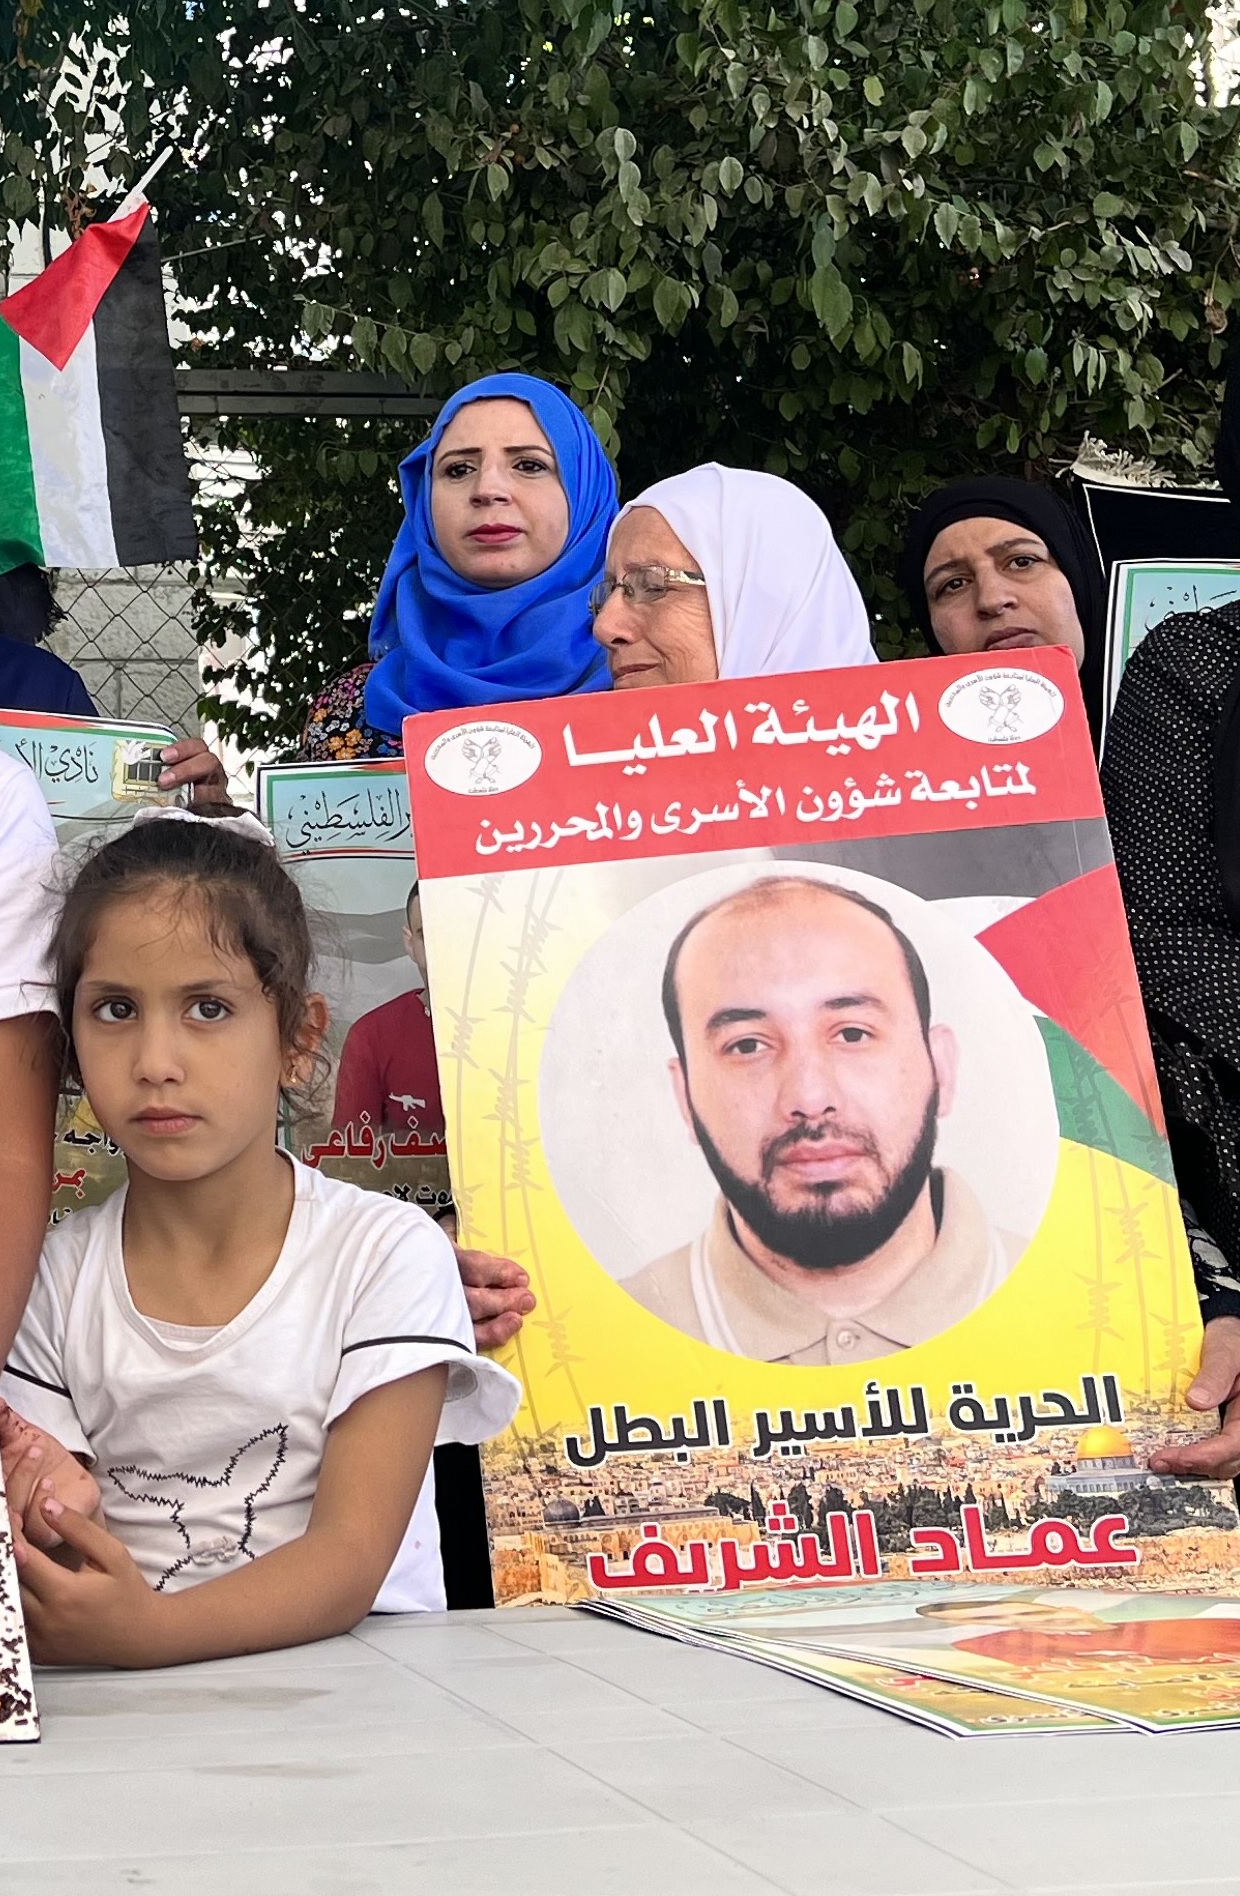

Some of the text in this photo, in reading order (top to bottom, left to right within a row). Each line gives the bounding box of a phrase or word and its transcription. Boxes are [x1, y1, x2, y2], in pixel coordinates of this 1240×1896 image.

[562, 689, 920, 776] الهيئة العليا
[650, 780, 787, 836] الأسرى
[796, 773, 902, 823] شؤون
[904, 761, 1037, 811] لمتابعة
[475, 801, 644, 856] والمحررين
[565, 1375, 1123, 1468] الحرية للأسير البطل
[588, 1502, 1139, 1592] عماد الشريف
